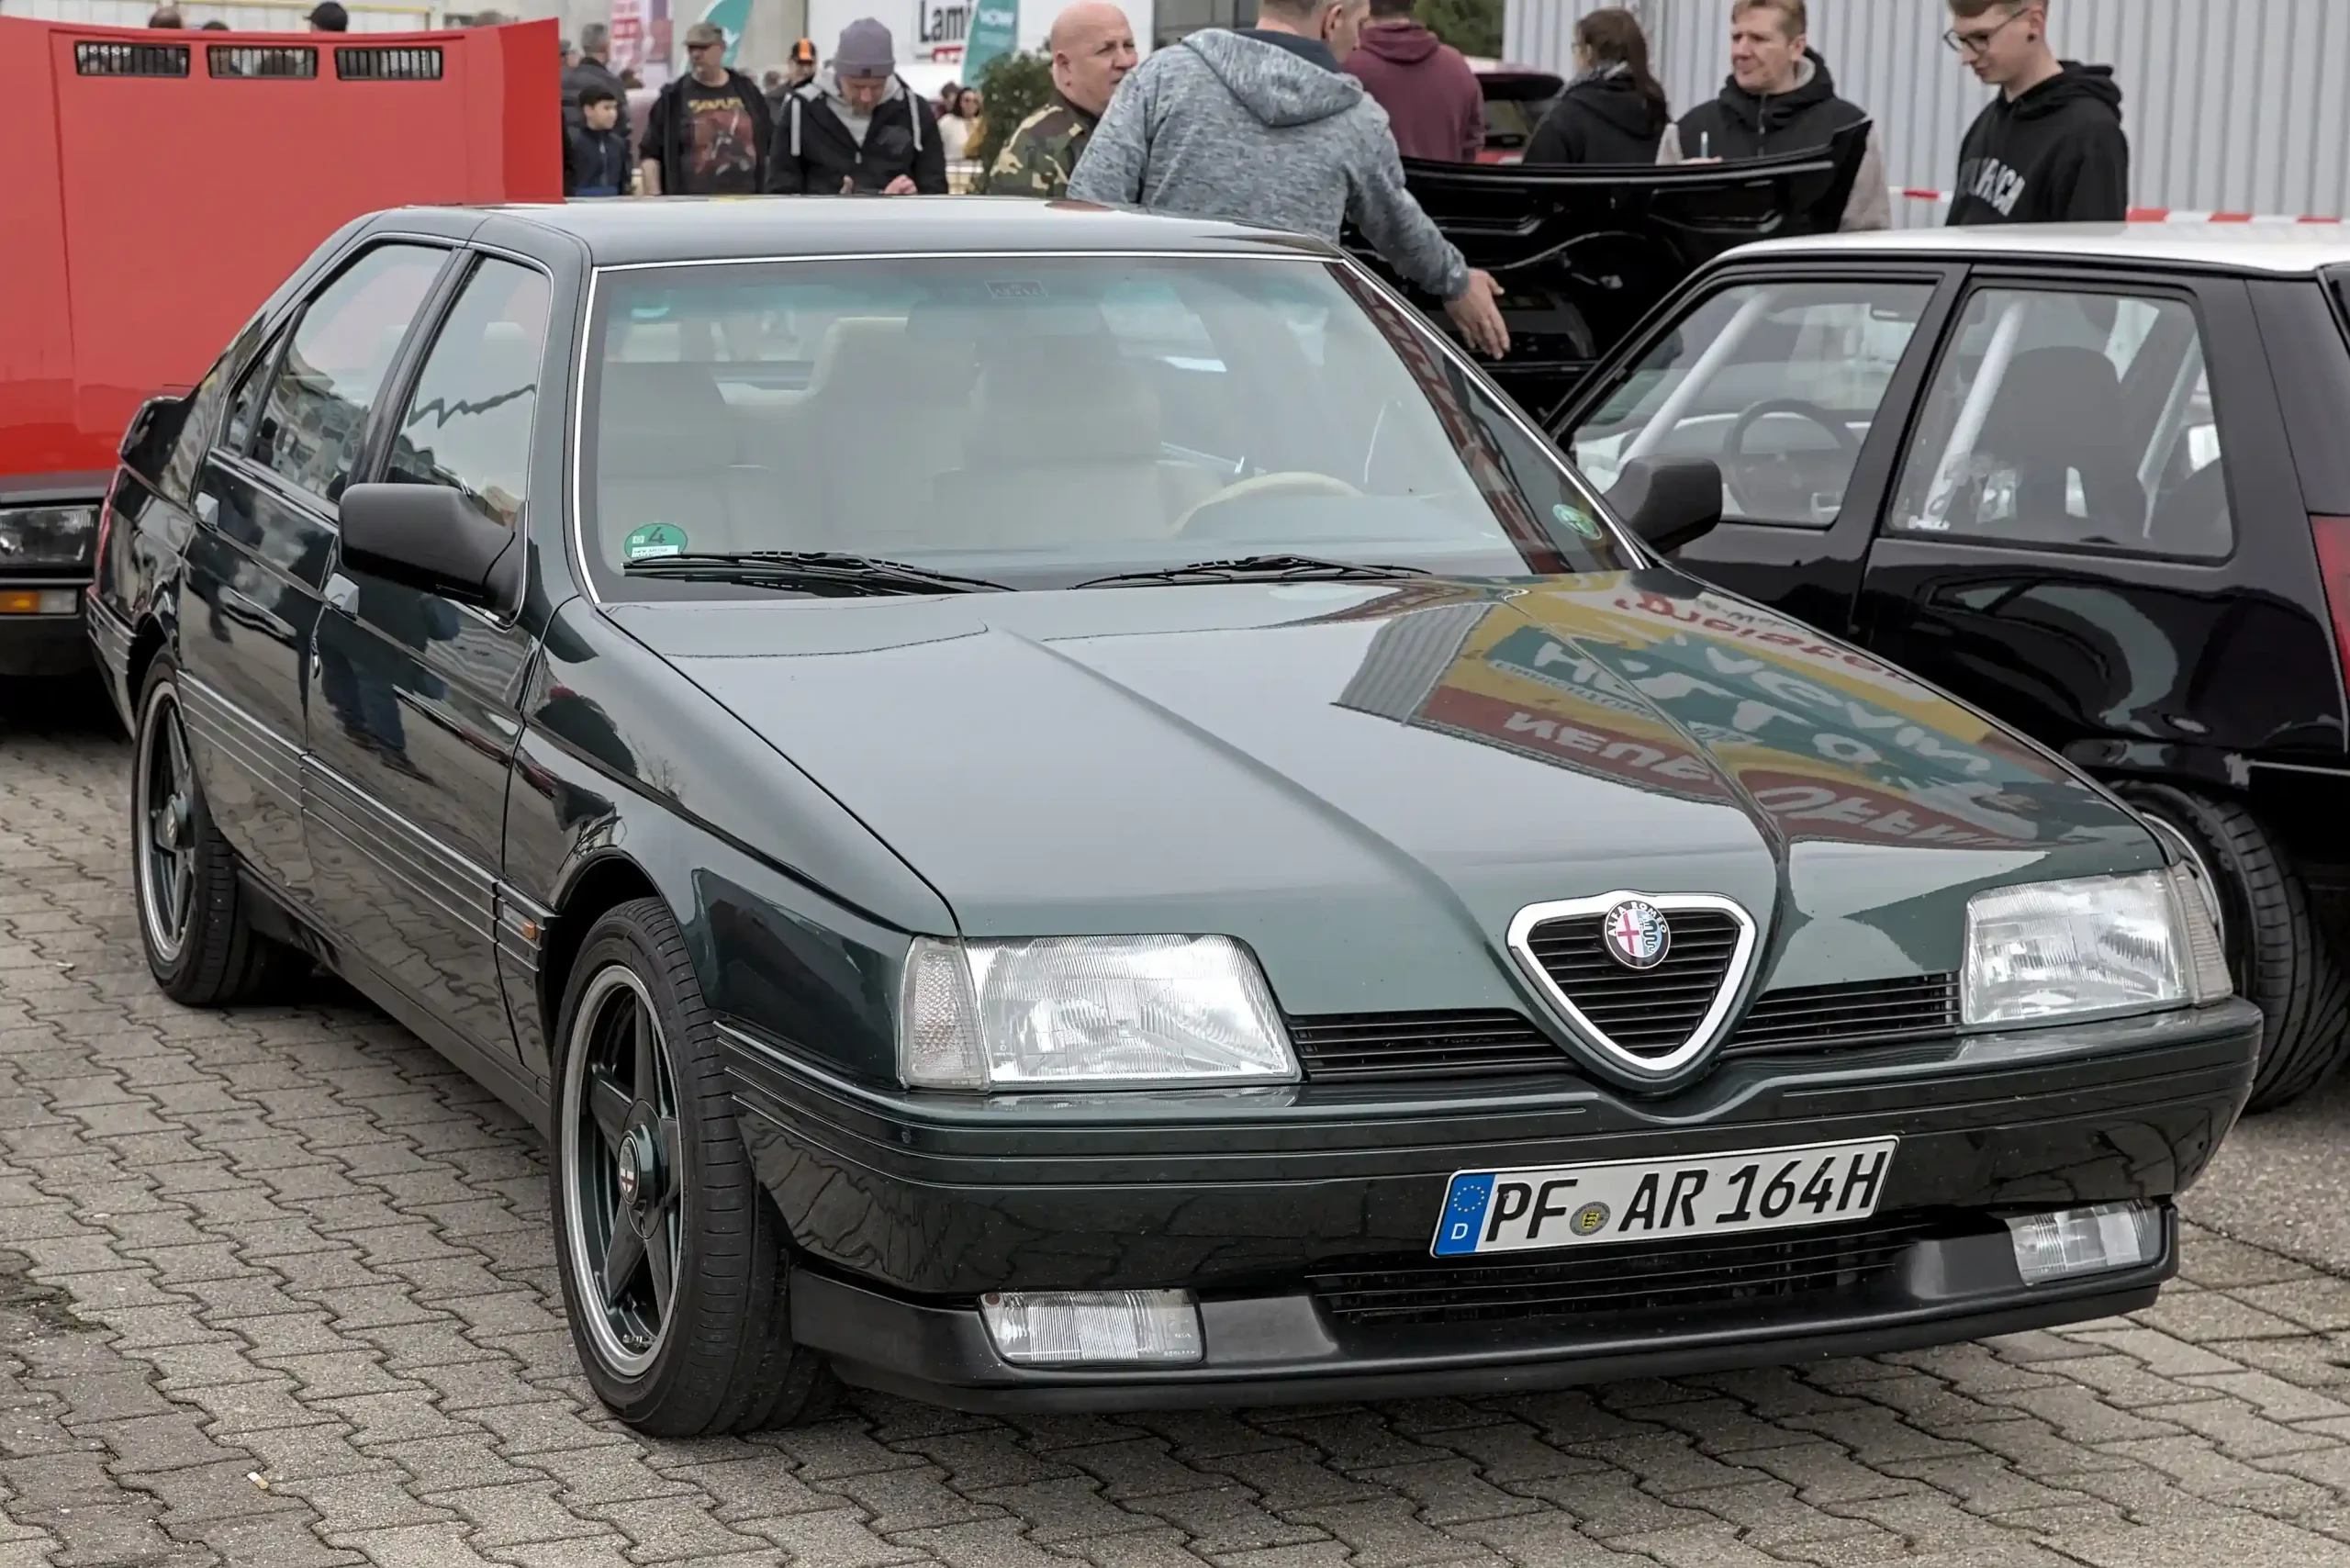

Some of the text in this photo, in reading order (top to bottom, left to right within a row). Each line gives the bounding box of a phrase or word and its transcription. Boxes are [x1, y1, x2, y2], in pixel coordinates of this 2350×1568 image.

[648, 526, 666, 543] 4
[1607, 902, 1667, 937] ALFA ROMEO
[1451, 1223, 1469, 1240] D
[1485, 1179, 1578, 1241] PF
[1617, 1170, 1708, 1231] AR
[1716, 1151, 1887, 1224] 164H
